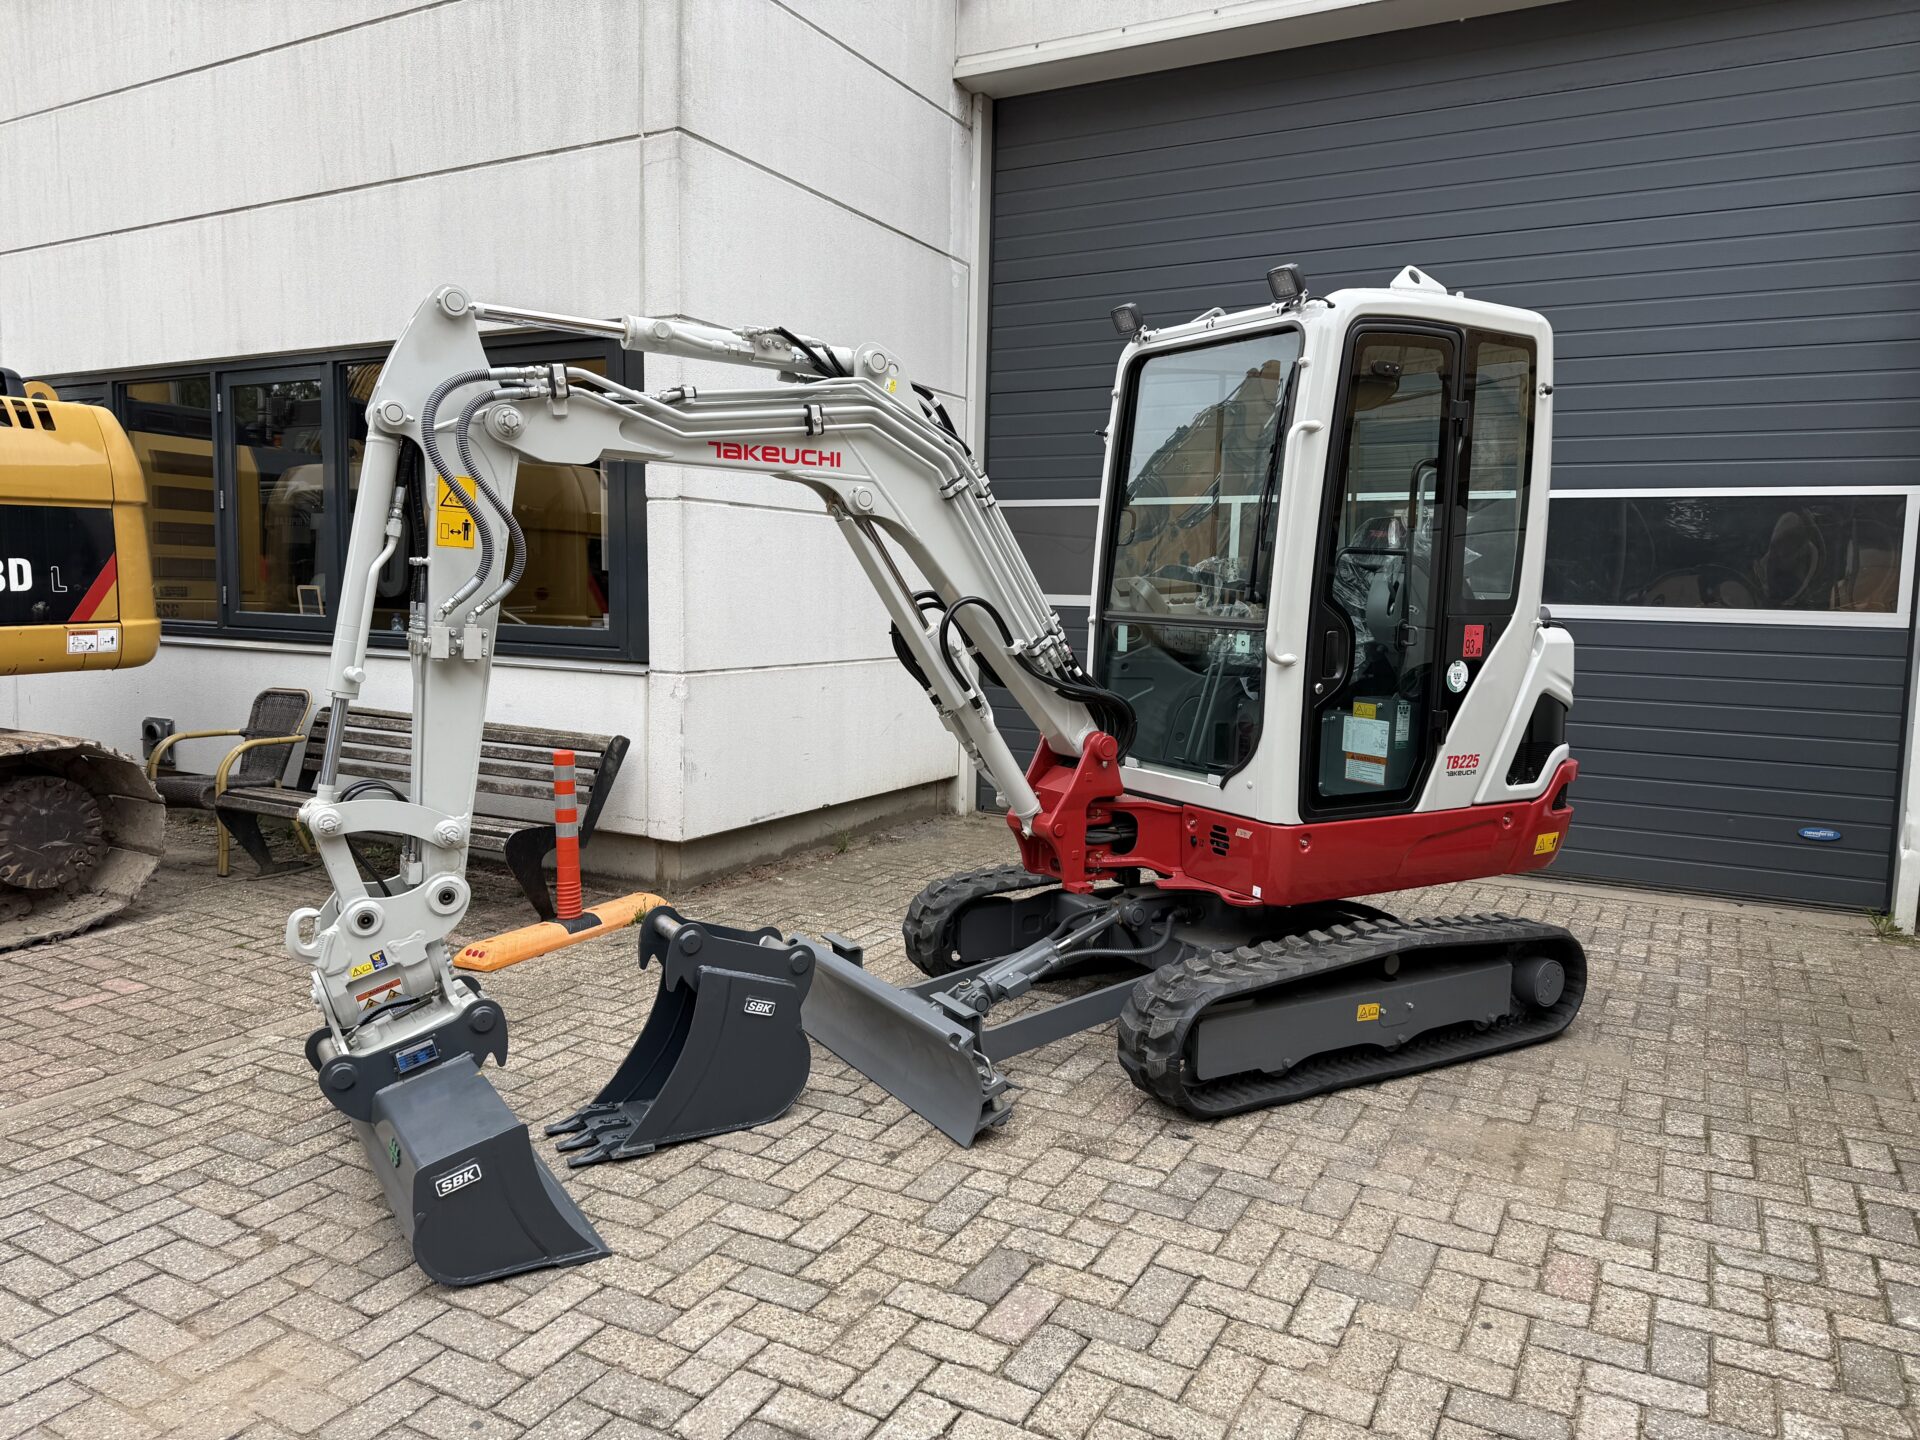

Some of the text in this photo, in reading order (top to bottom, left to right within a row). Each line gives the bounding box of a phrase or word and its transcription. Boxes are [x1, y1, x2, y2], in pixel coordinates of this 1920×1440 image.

[0, 557, 68, 593] D L
[1465, 639, 1475, 654] 93
[1446, 753, 1480, 769] TB225
[747, 1001, 772, 1013] SBK
[441, 1168, 475, 1193] SBK
